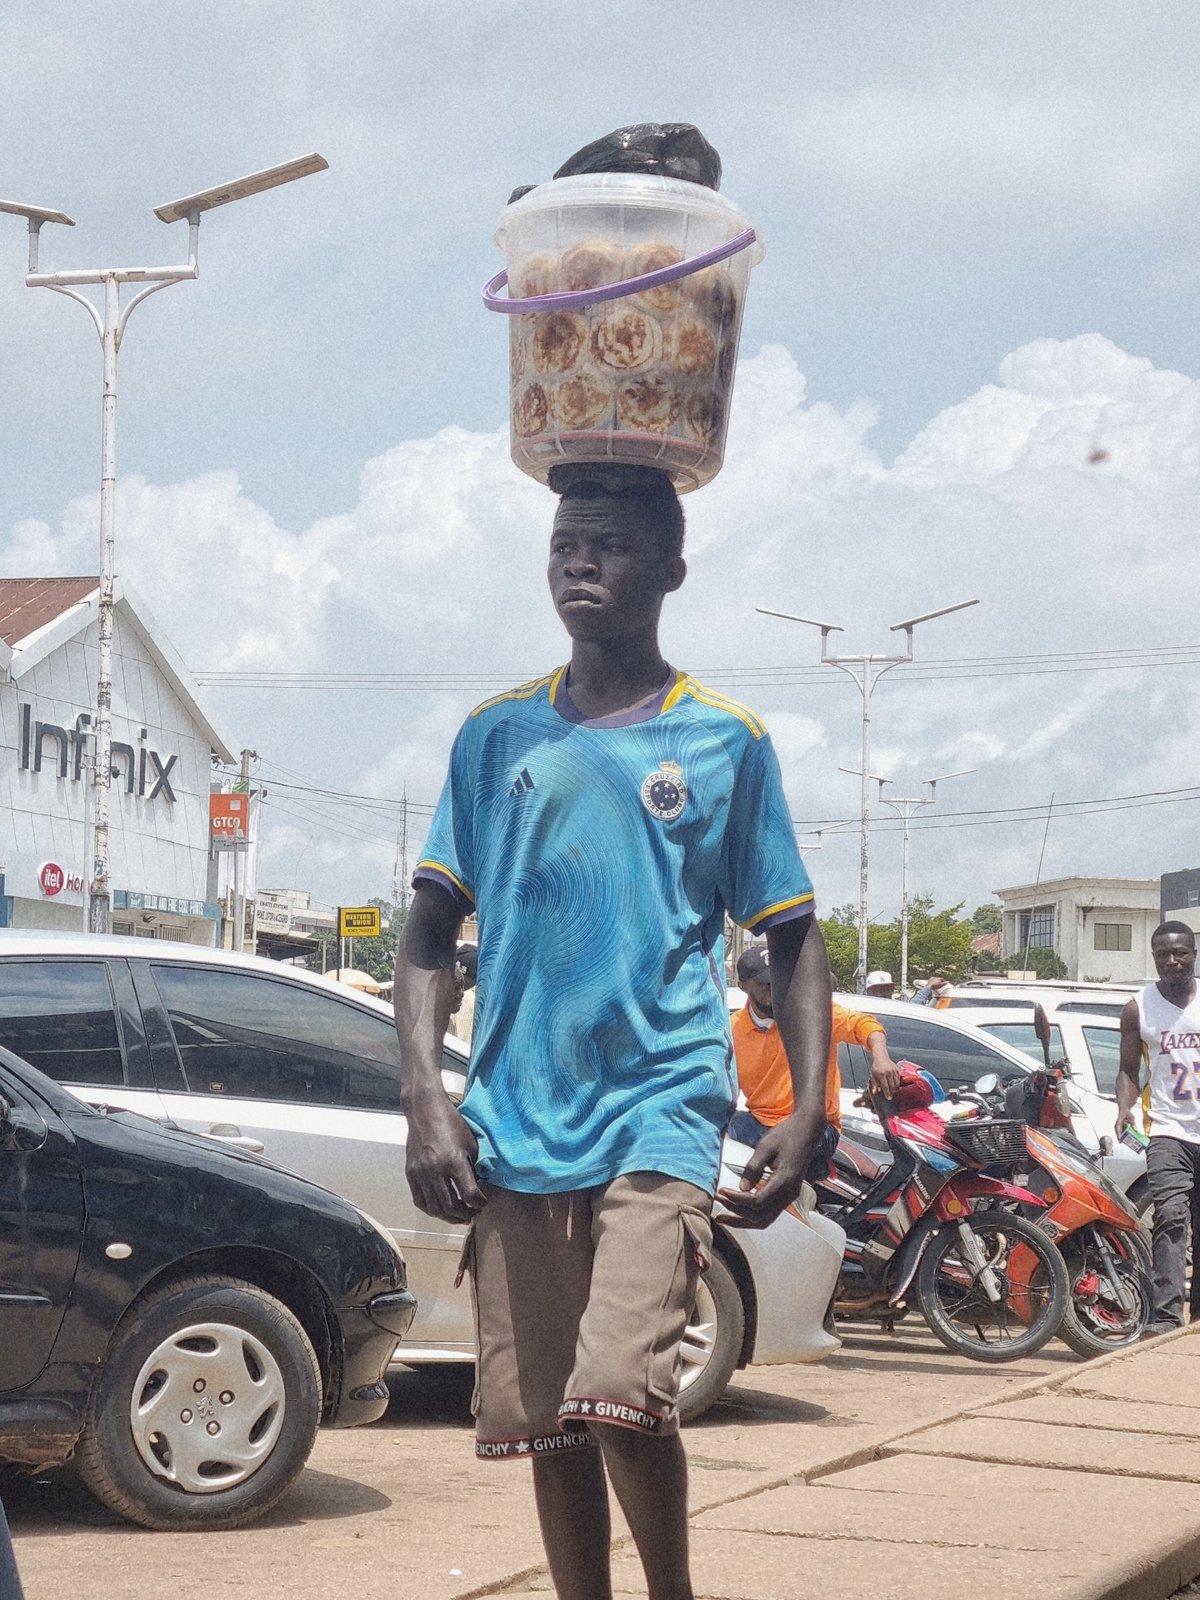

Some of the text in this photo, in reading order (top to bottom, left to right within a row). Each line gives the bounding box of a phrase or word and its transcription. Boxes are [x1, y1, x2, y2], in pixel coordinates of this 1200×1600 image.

[650, 774, 684, 794] CRUZEIRO
[44, 868, 61, 888] itel
[1159, 1030, 1200, 1055] LAKE
[595, 1401, 656, 1429] GIVENCHY
[533, 1434, 591, 1451] GIVENCHY
